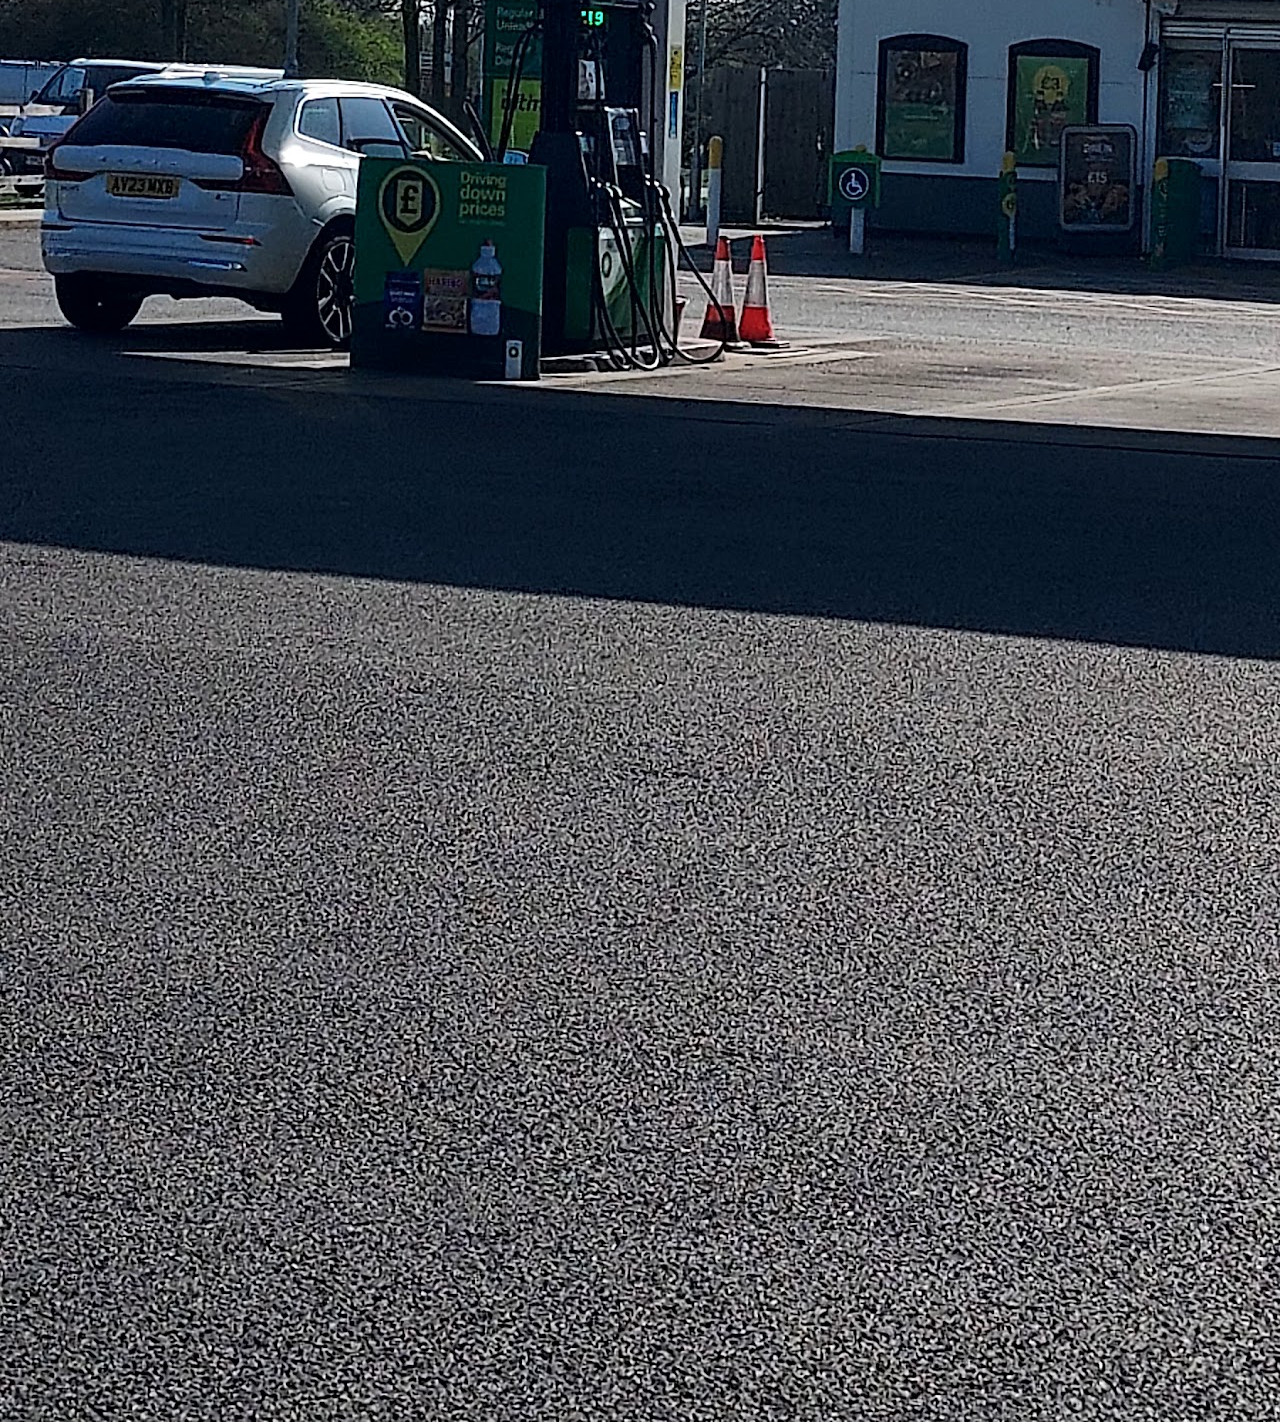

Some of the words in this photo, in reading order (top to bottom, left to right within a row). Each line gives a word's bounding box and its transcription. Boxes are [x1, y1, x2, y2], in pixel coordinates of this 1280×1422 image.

[460, 171, 508, 188] Driving
[459, 184, 506, 202] down
[458, 199, 506, 218] prices
